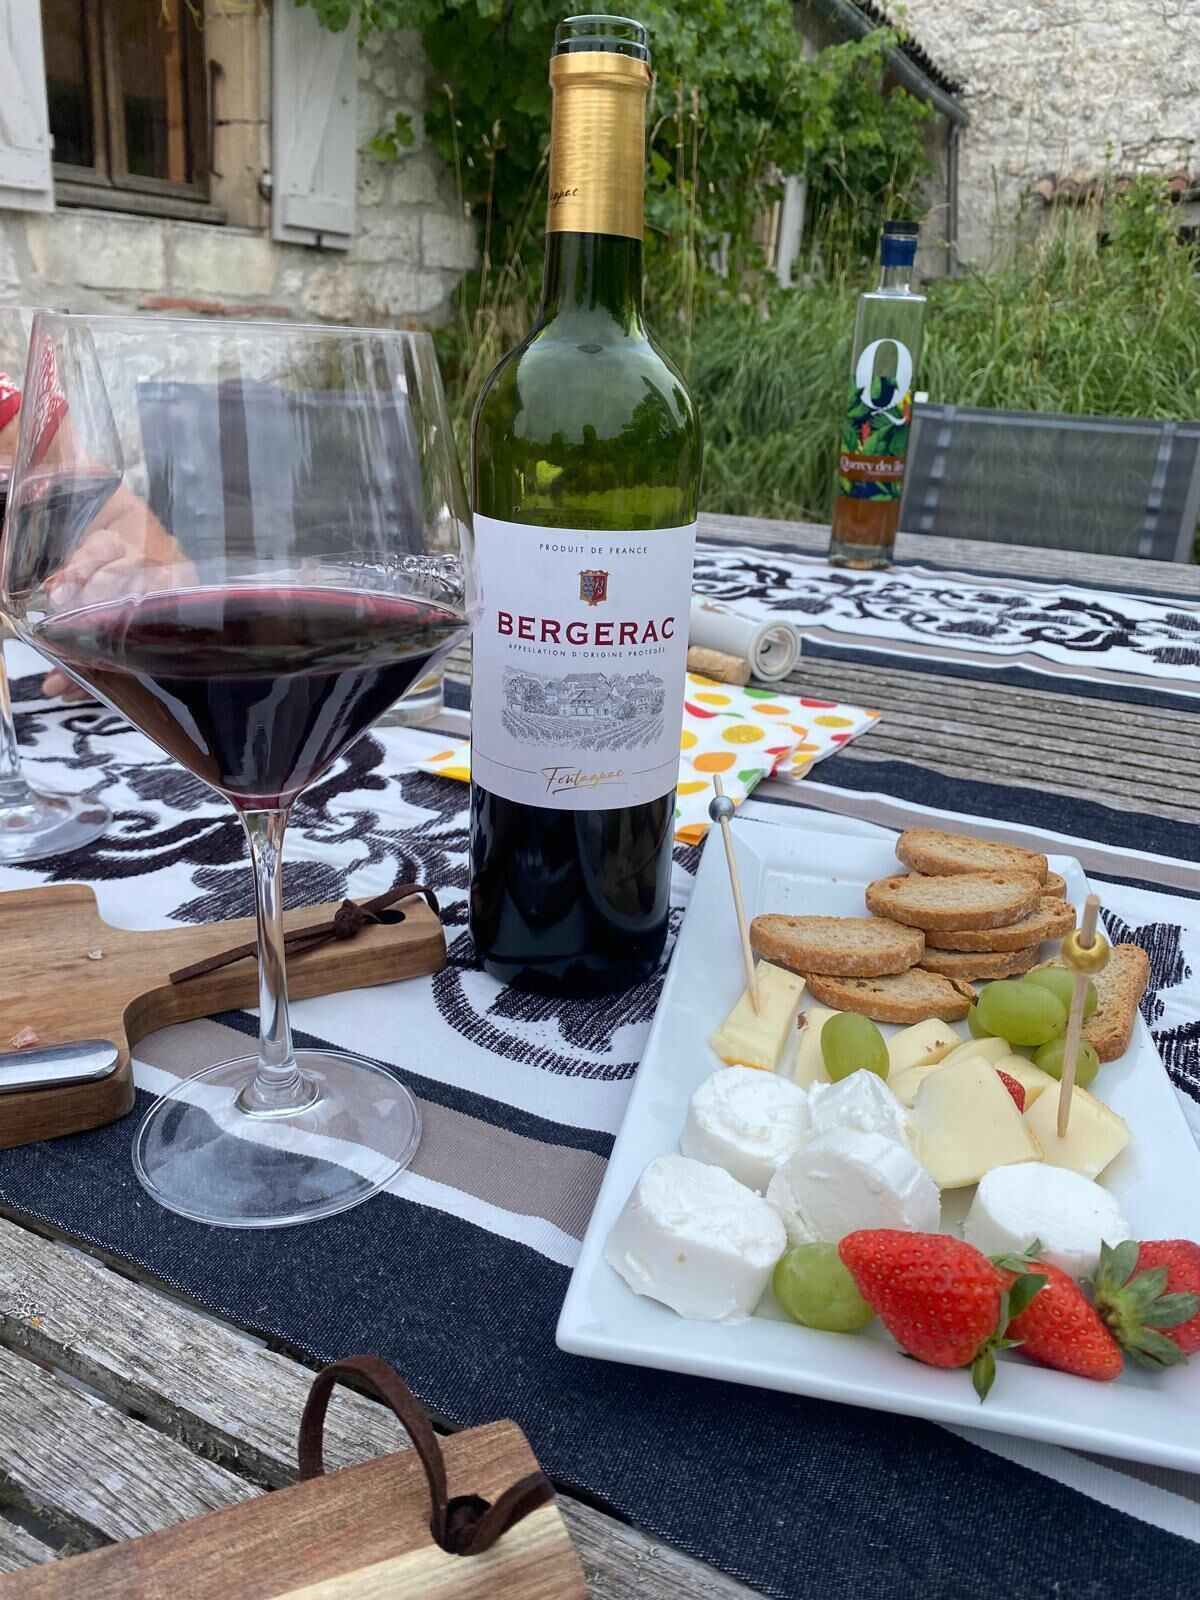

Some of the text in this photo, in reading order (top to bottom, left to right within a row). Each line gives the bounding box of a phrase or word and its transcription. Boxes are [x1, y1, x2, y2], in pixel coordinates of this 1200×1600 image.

[856, 338, 913, 426] Q
[539, 543, 649, 554] PRODUIT DE FRANCE
[497, 610, 676, 646] BERGERAC
[508, 643, 567, 657] APPELLATION
[572, 650, 623, 658] D'ORIGINE
